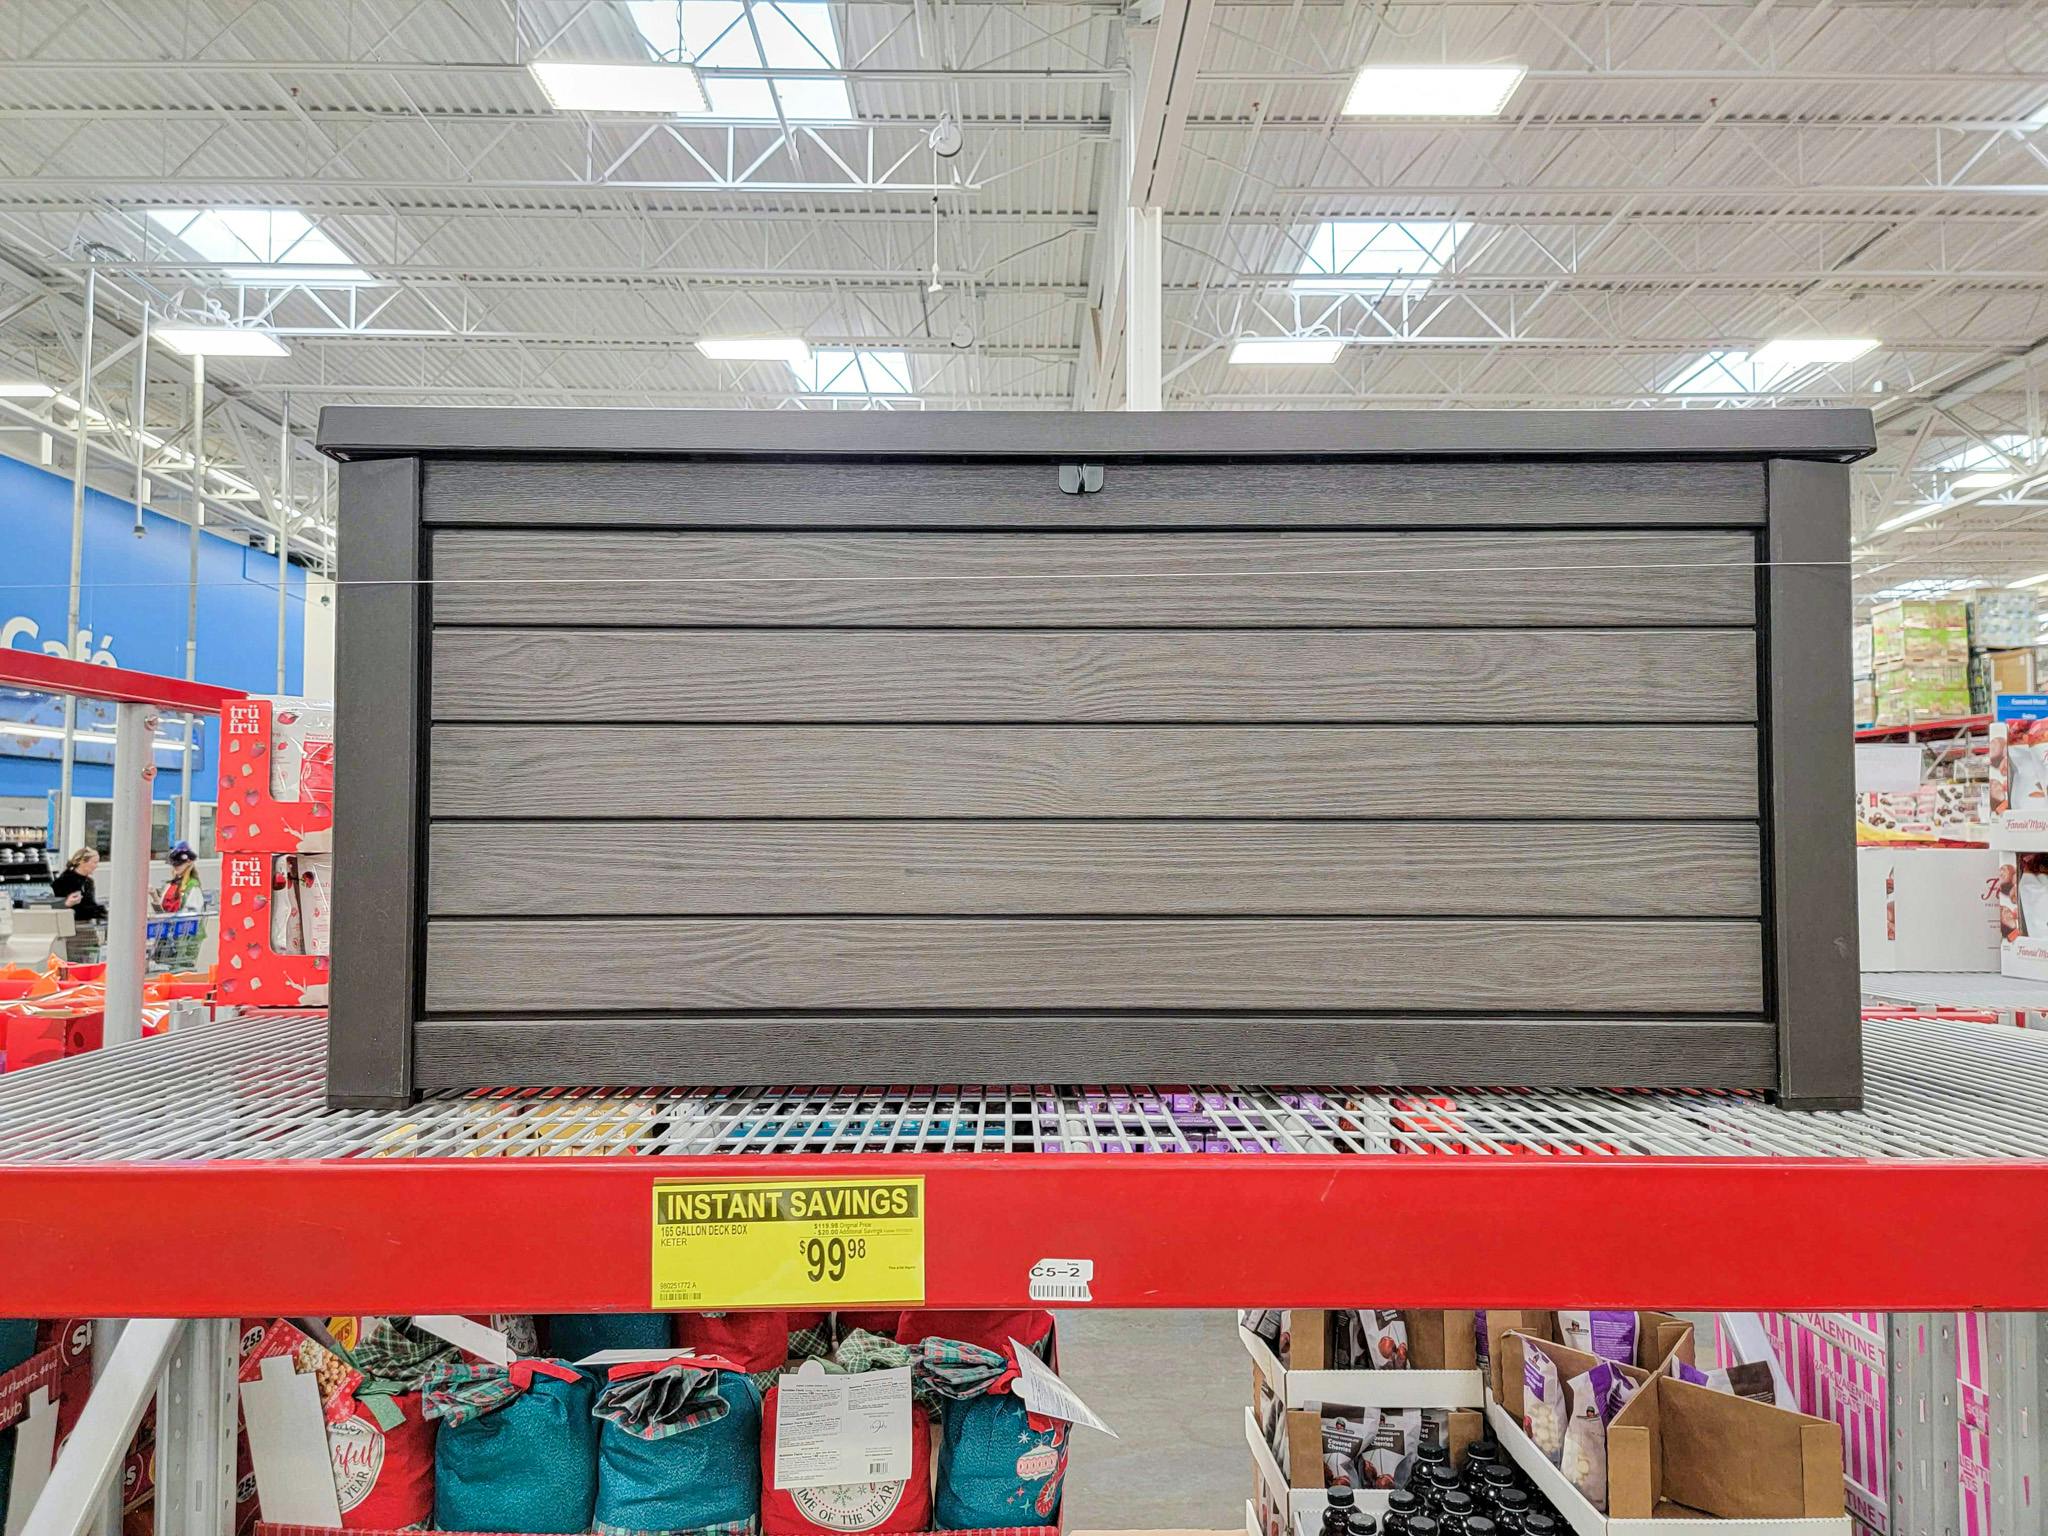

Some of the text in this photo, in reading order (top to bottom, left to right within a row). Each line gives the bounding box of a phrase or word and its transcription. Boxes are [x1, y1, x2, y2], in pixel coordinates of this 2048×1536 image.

[229, 705, 260, 719] trü
[229, 719, 260, 734] frü
[231, 857, 261, 872] trü
[230, 871, 261, 887] frü
[668, 1188, 908, 1220] INSTANT SAVINGS
[661, 1224, 748, 1237] 165 GALLON DECK BOX
[661, 1238, 688, 1246] KETER
[242, 1329, 262, 1351] 255
[1807, 1313, 1876, 1361] VALENTINE
[9, 1372, 38, 1393] Flavors
[1328, 1439, 1352, 1447] Covered
[1328, 1444, 1352, 1453] Cherries
[237, 1476, 256, 1498] 255
[345, 1471, 369, 1499] YEAR
[818, 1509, 836, 1522] OF
[841, 1513, 865, 1525] THE
[867, 1484, 895, 1518] YEAR
